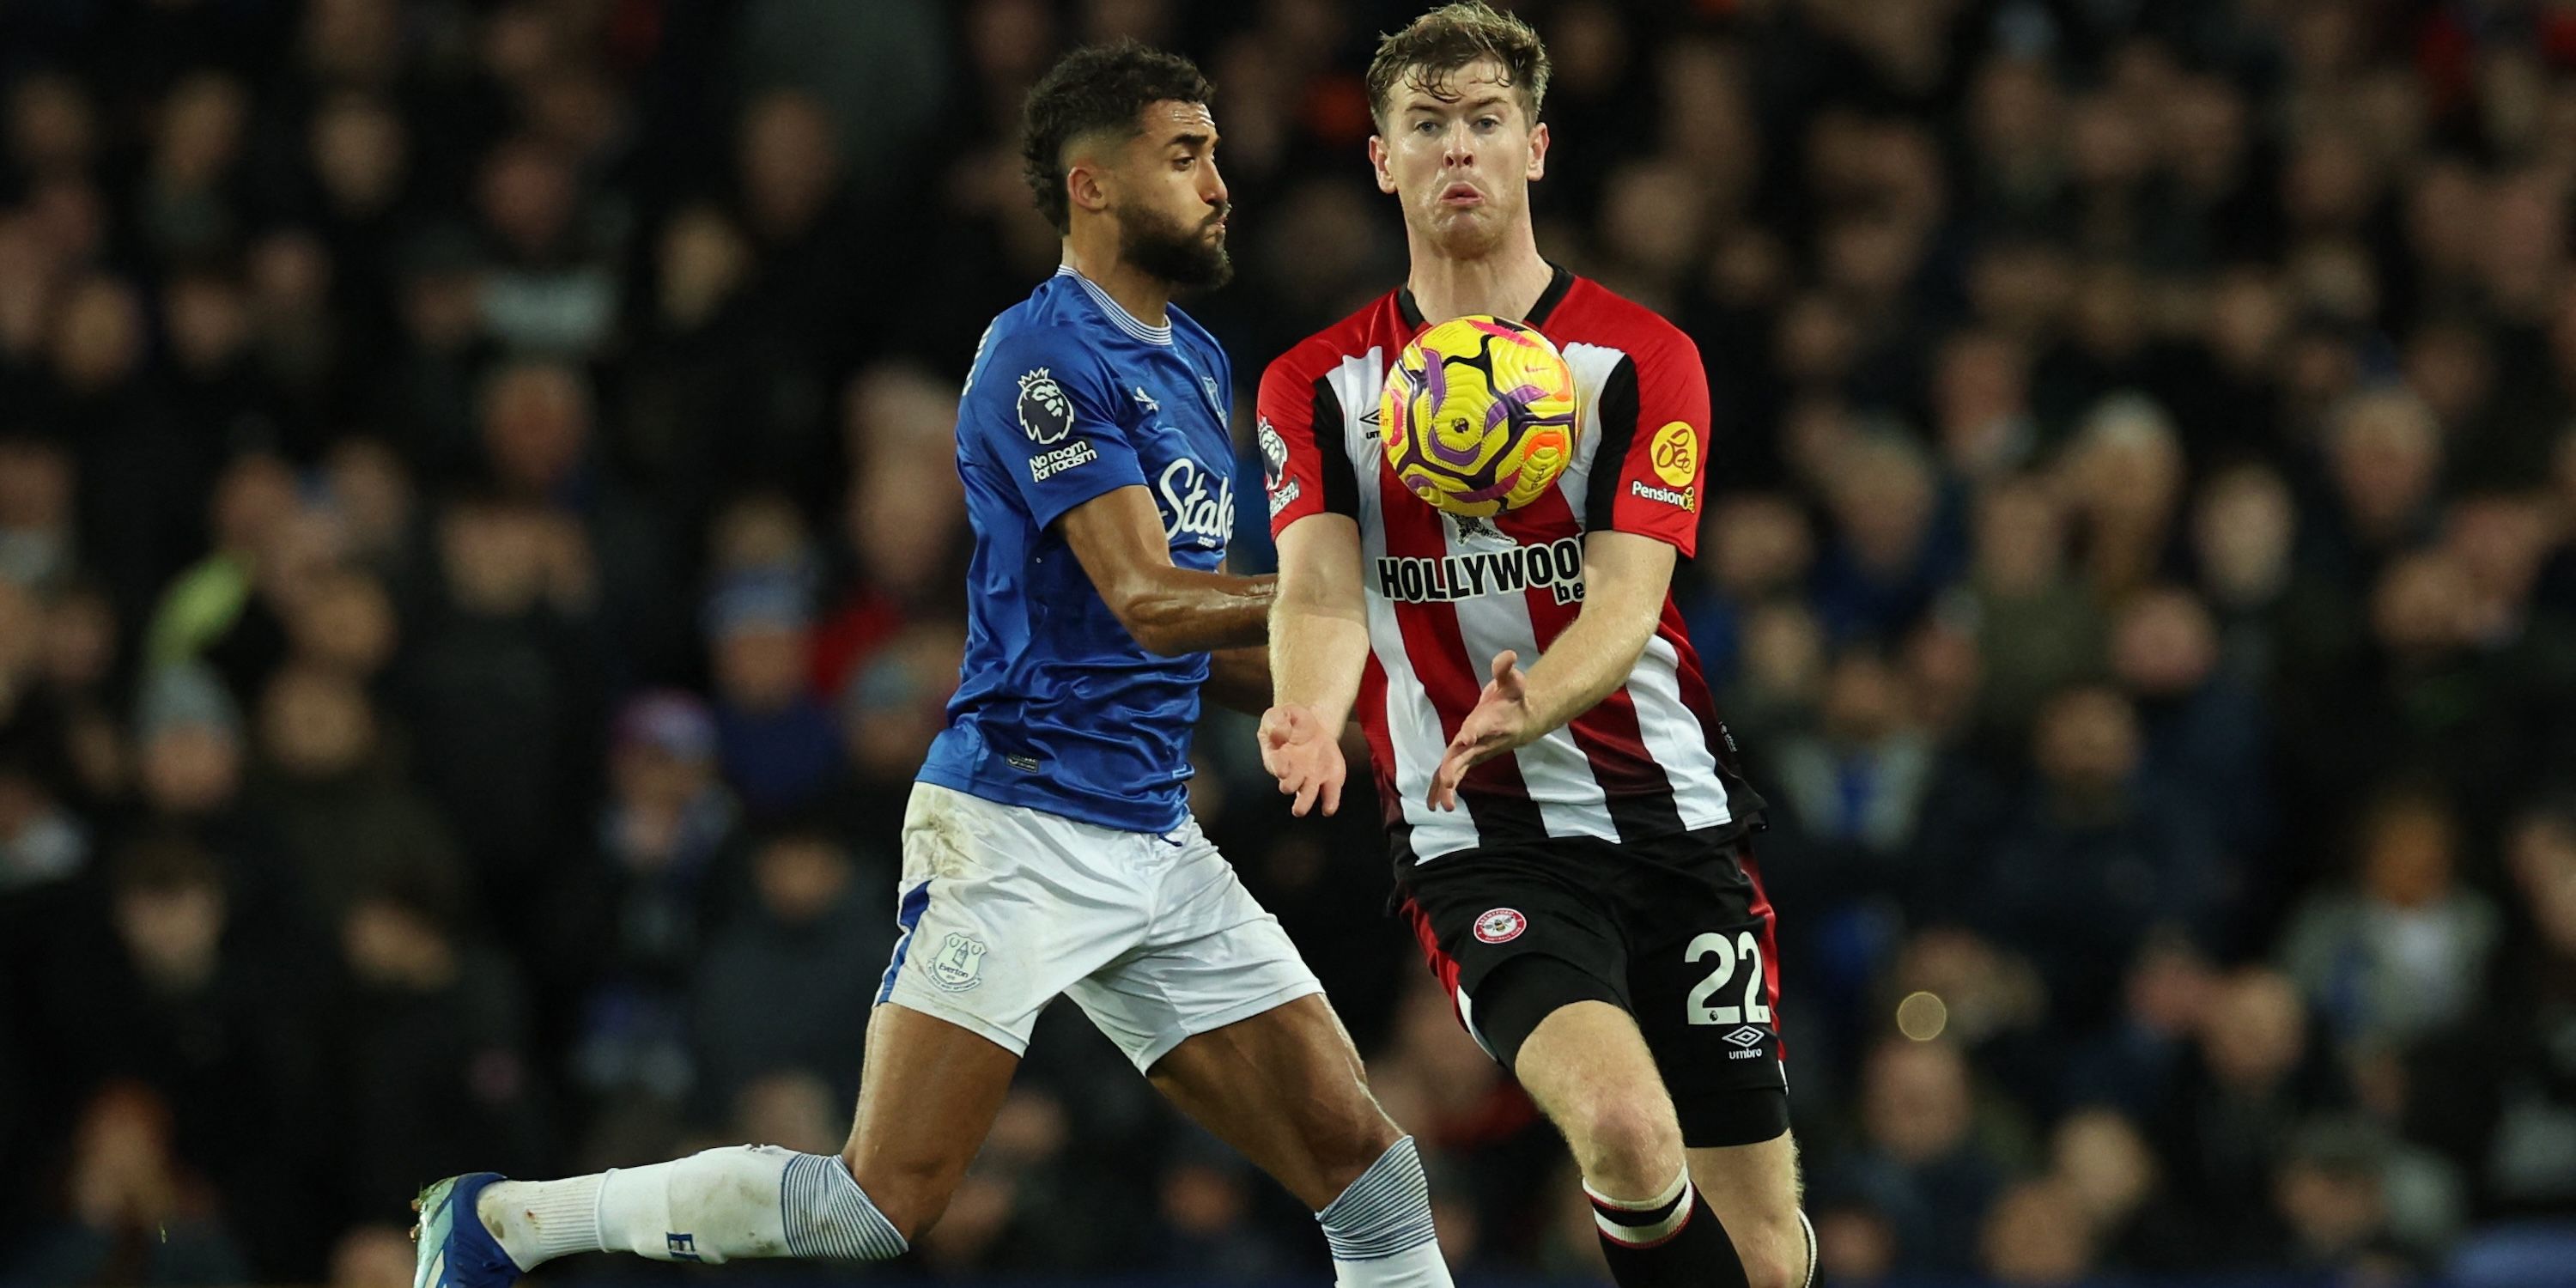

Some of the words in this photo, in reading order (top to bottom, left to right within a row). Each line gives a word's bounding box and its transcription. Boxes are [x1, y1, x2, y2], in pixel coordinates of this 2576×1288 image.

[1029, 455, 1048, 473] No
[1048, 440, 1088, 463] room
[1032, 465, 1051, 483] for
[1050, 448, 1098, 474] racism
[1158, 457, 1236, 545] Stake
[939, 963, 969, 978] Everton
[1684, 930, 1771, 1025] 22
[1728, 1048, 1763, 1060] umbro
